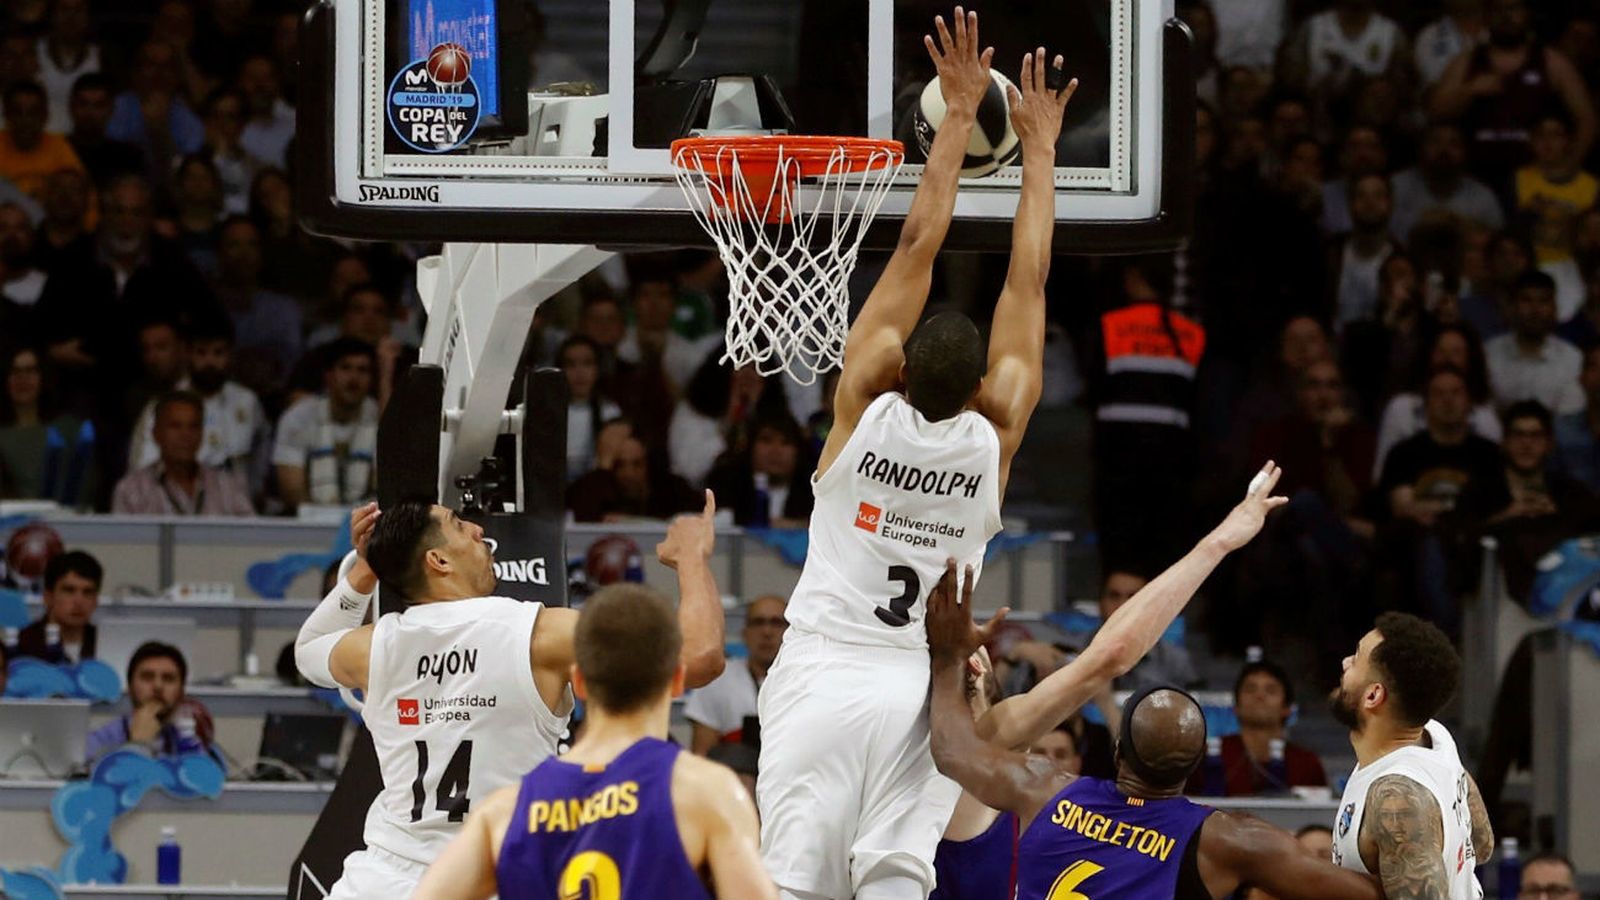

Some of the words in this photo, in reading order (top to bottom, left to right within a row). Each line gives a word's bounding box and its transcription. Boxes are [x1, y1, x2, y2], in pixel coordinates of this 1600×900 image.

[405, 94, 446, 104] MADRID
[448, 95, 463, 104] '19
[399, 107, 446, 123] COPA
[449, 111, 468, 121] DEL
[411, 123, 464, 143] REY
[358, 184, 441, 203] SPALDING
[856, 451, 982, 499] RANDOLPH
[881, 526, 937, 549] Europea
[884, 511, 965, 539] Universidad
[873, 565, 920, 627] 3
[416, 645, 478, 685] AYÓN
[424, 695, 497, 710] Universidad
[409, 740, 474, 823] 14
[528, 780, 640, 834] PANGOS
[1051, 799, 1176, 862] SINGLETON
